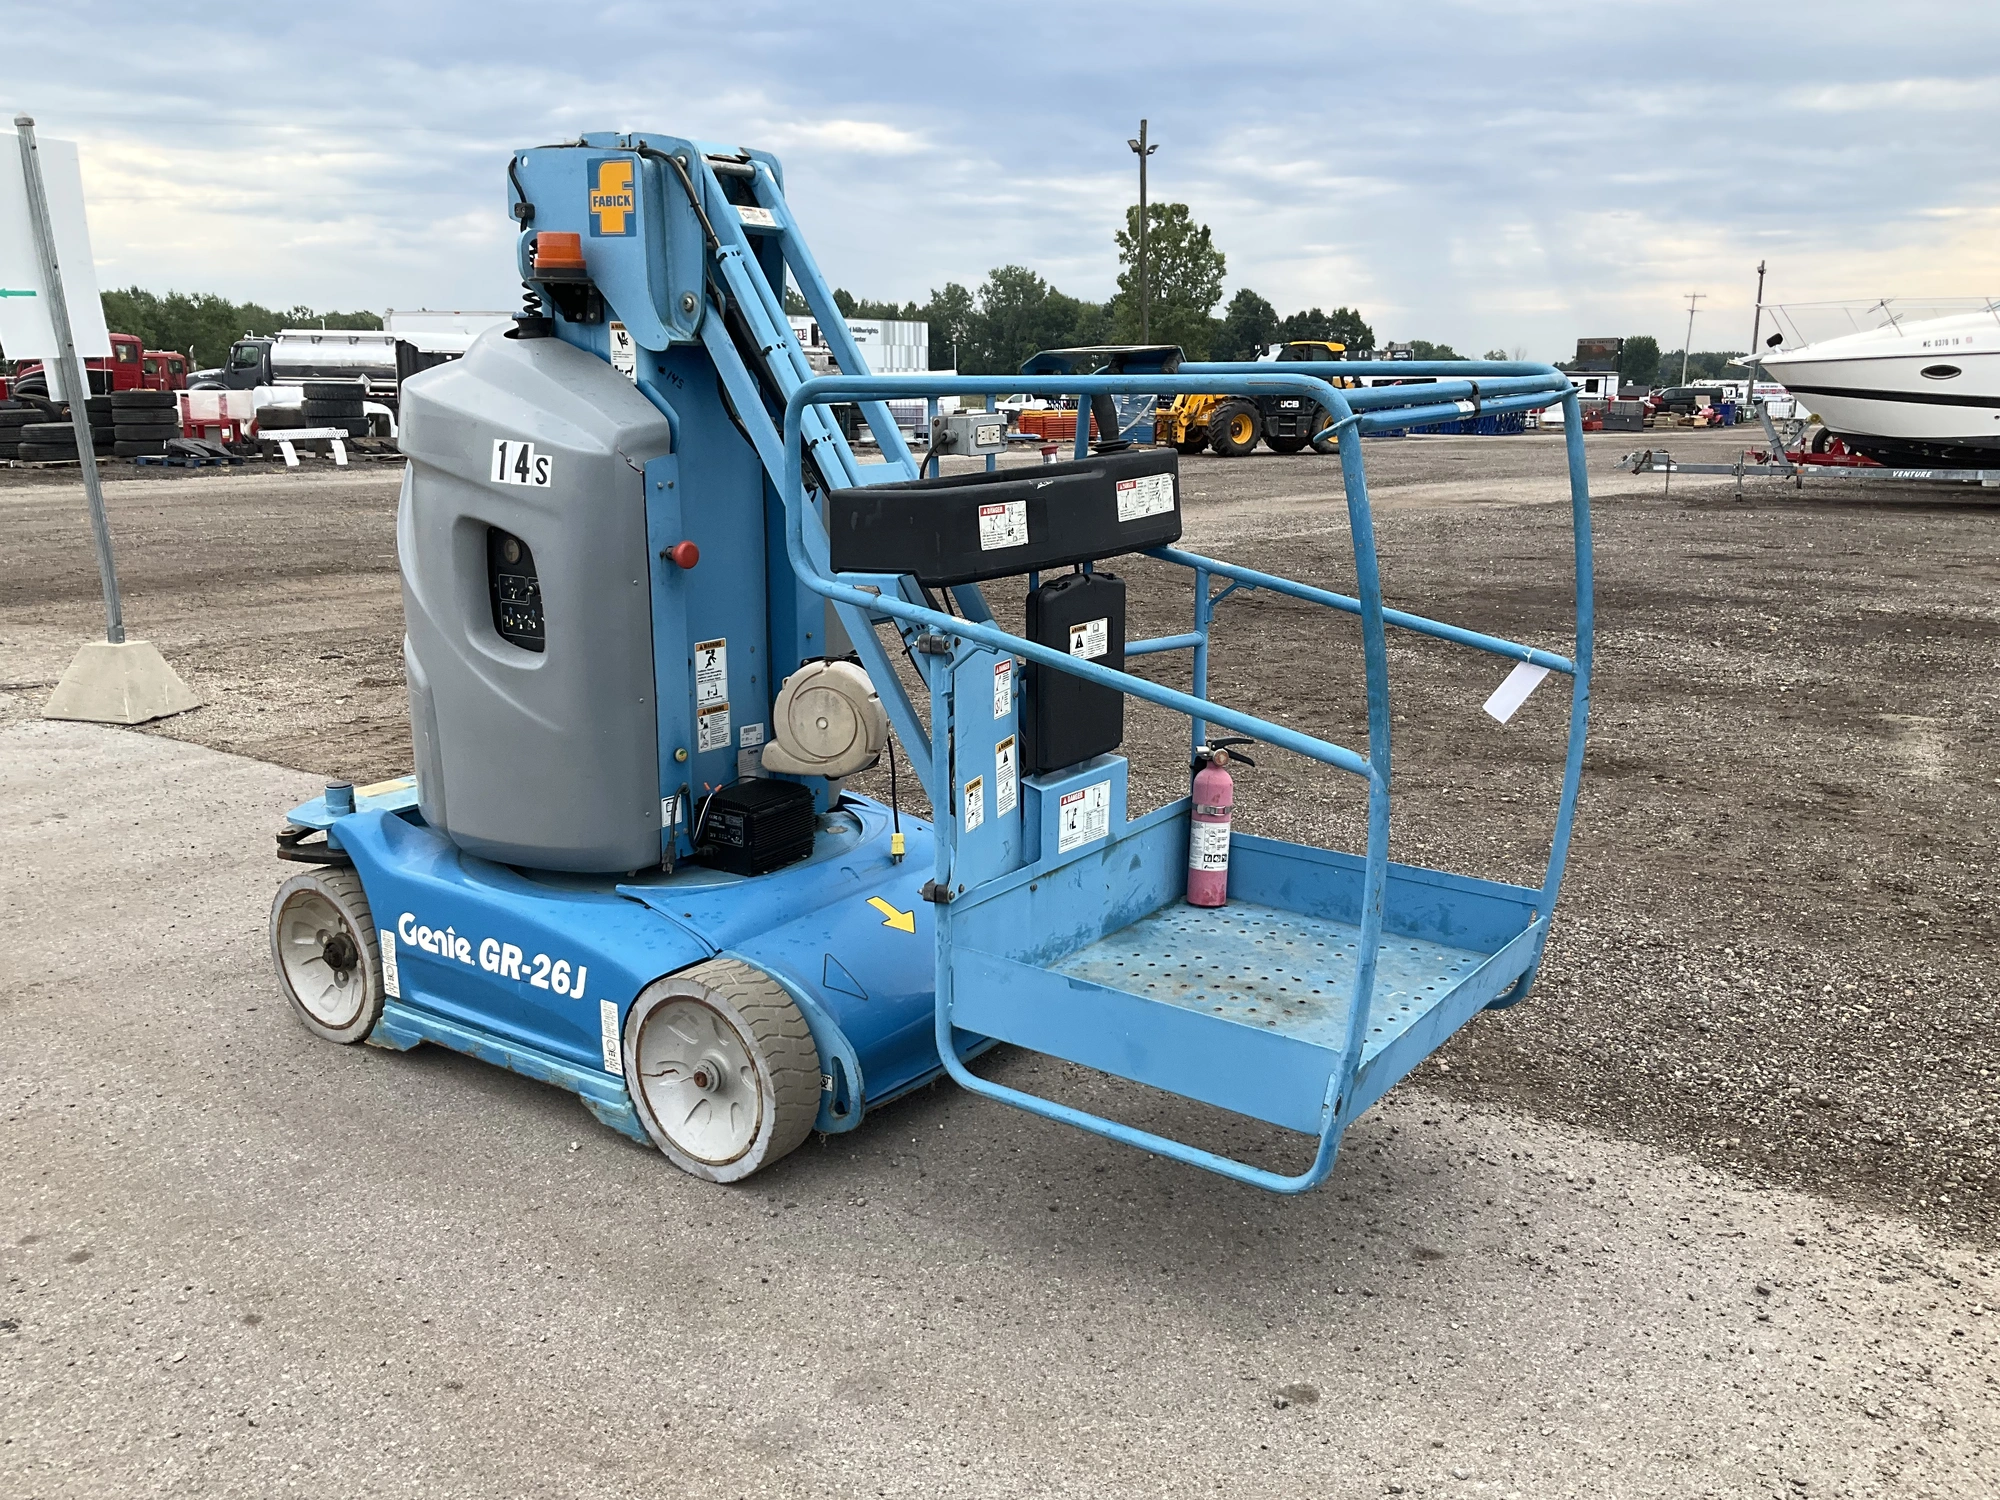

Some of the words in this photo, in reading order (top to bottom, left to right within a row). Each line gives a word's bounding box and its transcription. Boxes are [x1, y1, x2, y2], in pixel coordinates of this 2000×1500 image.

[592, 195, 632, 207] FABICK
[852, 326, 879, 335] Millwrights
[1280, 400, 1300, 408] JCB
[1892, 470, 1933, 478] VENTURE
[398, 912, 476, 966] Genie
[479, 937, 588, 1000] GR-26J
